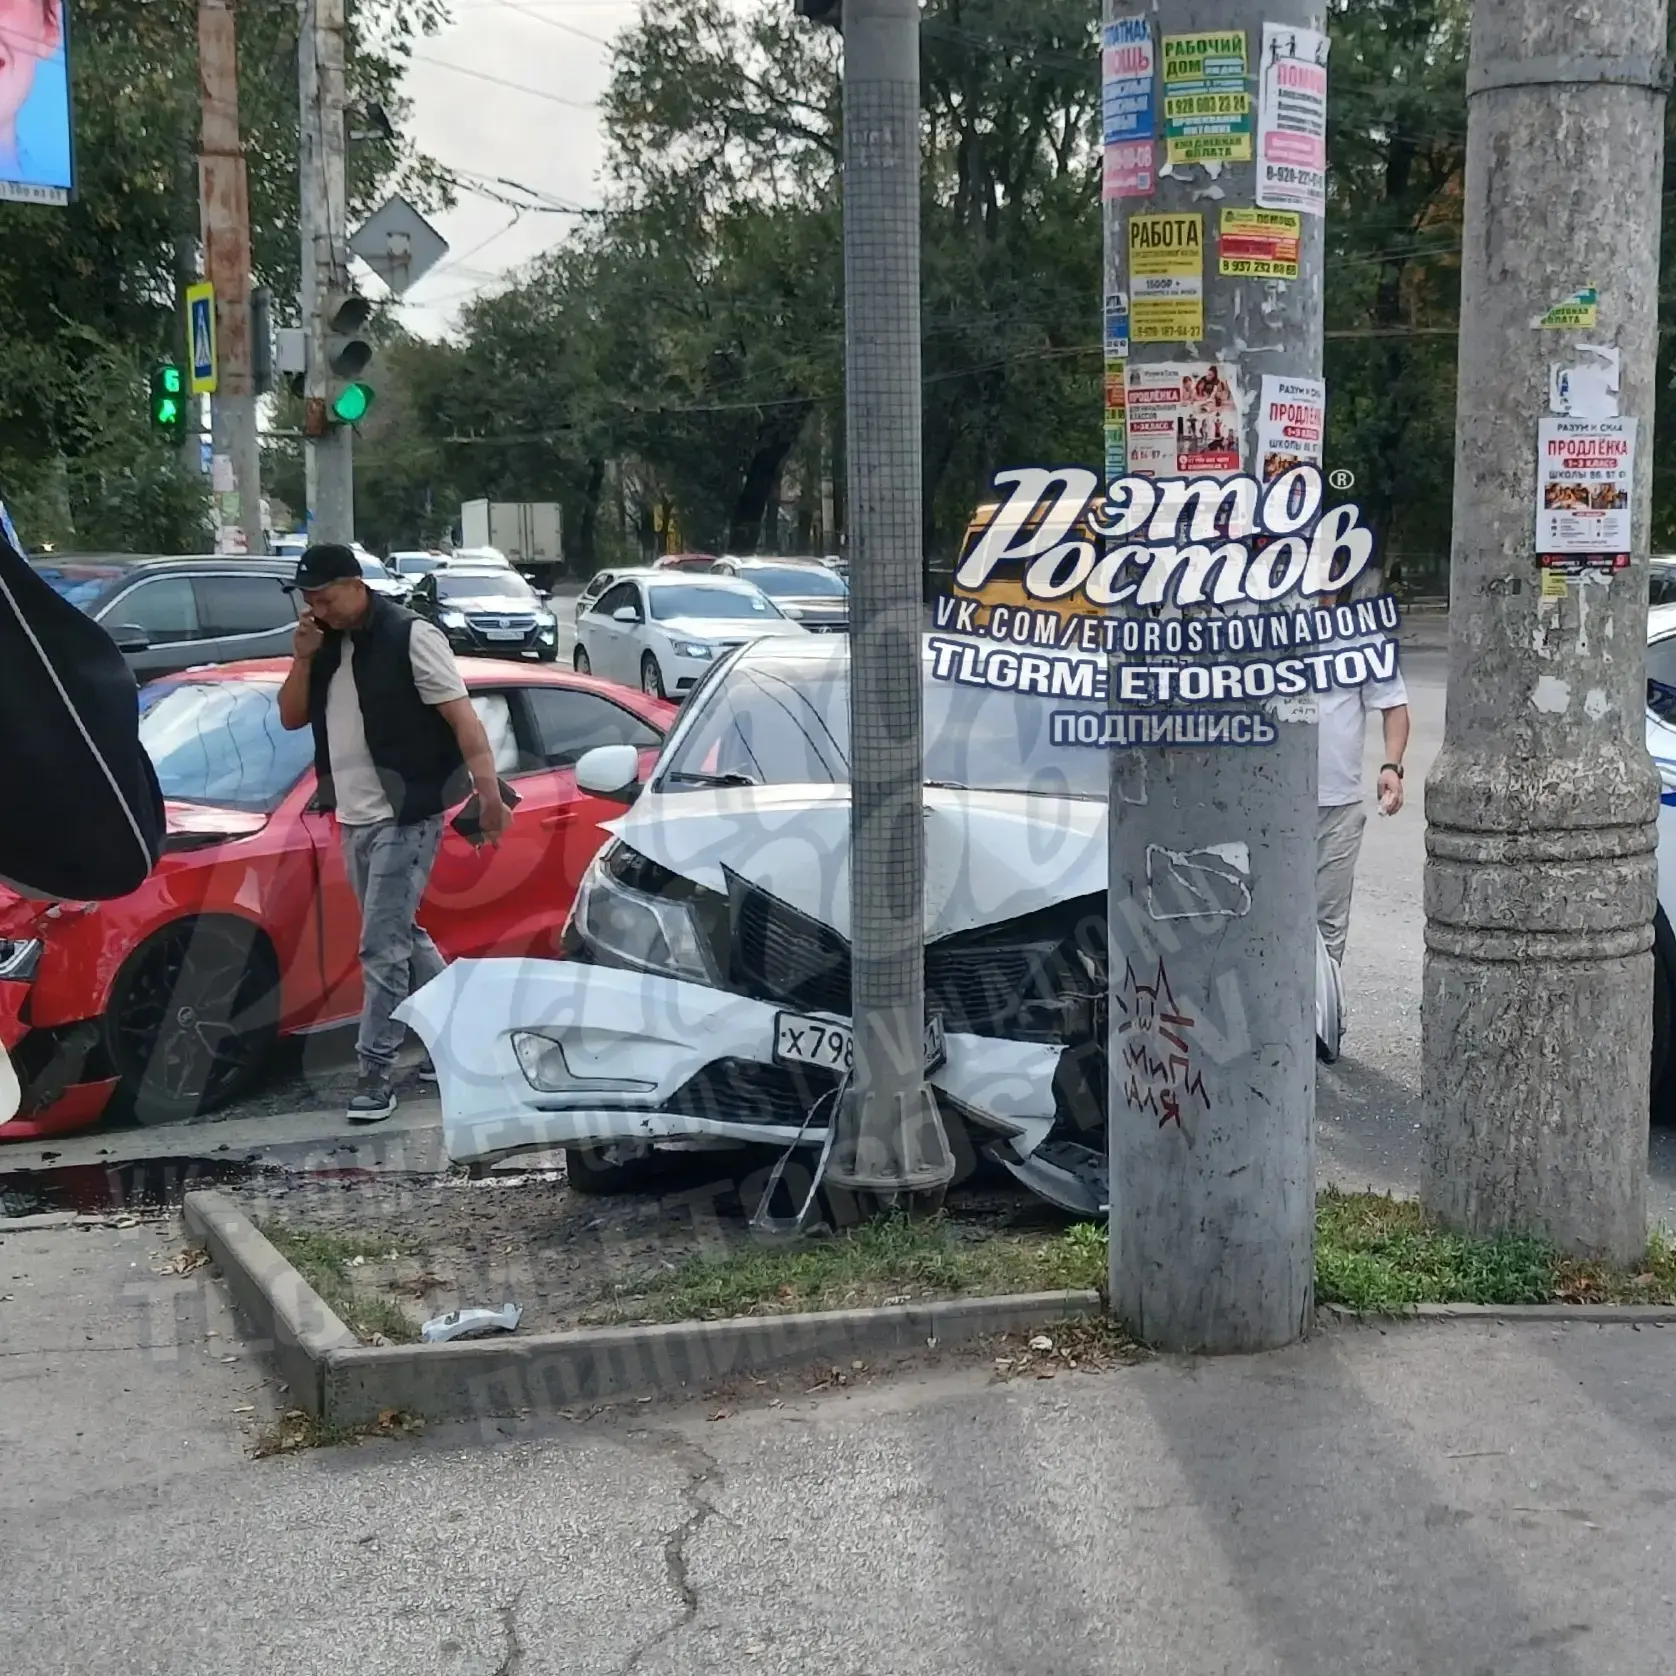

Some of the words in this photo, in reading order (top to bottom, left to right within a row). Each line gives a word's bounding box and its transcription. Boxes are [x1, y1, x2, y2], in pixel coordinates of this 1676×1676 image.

[1165, 35, 1242, 57] РАБОЧИЙ
[1166, 60, 1201, 79] ДОМ
[1130, 220, 1199, 248] РАБОТА
[165, 370, 179, 392] 6
[1548, 437, 1628, 457] ПРОДЛЁНКА
